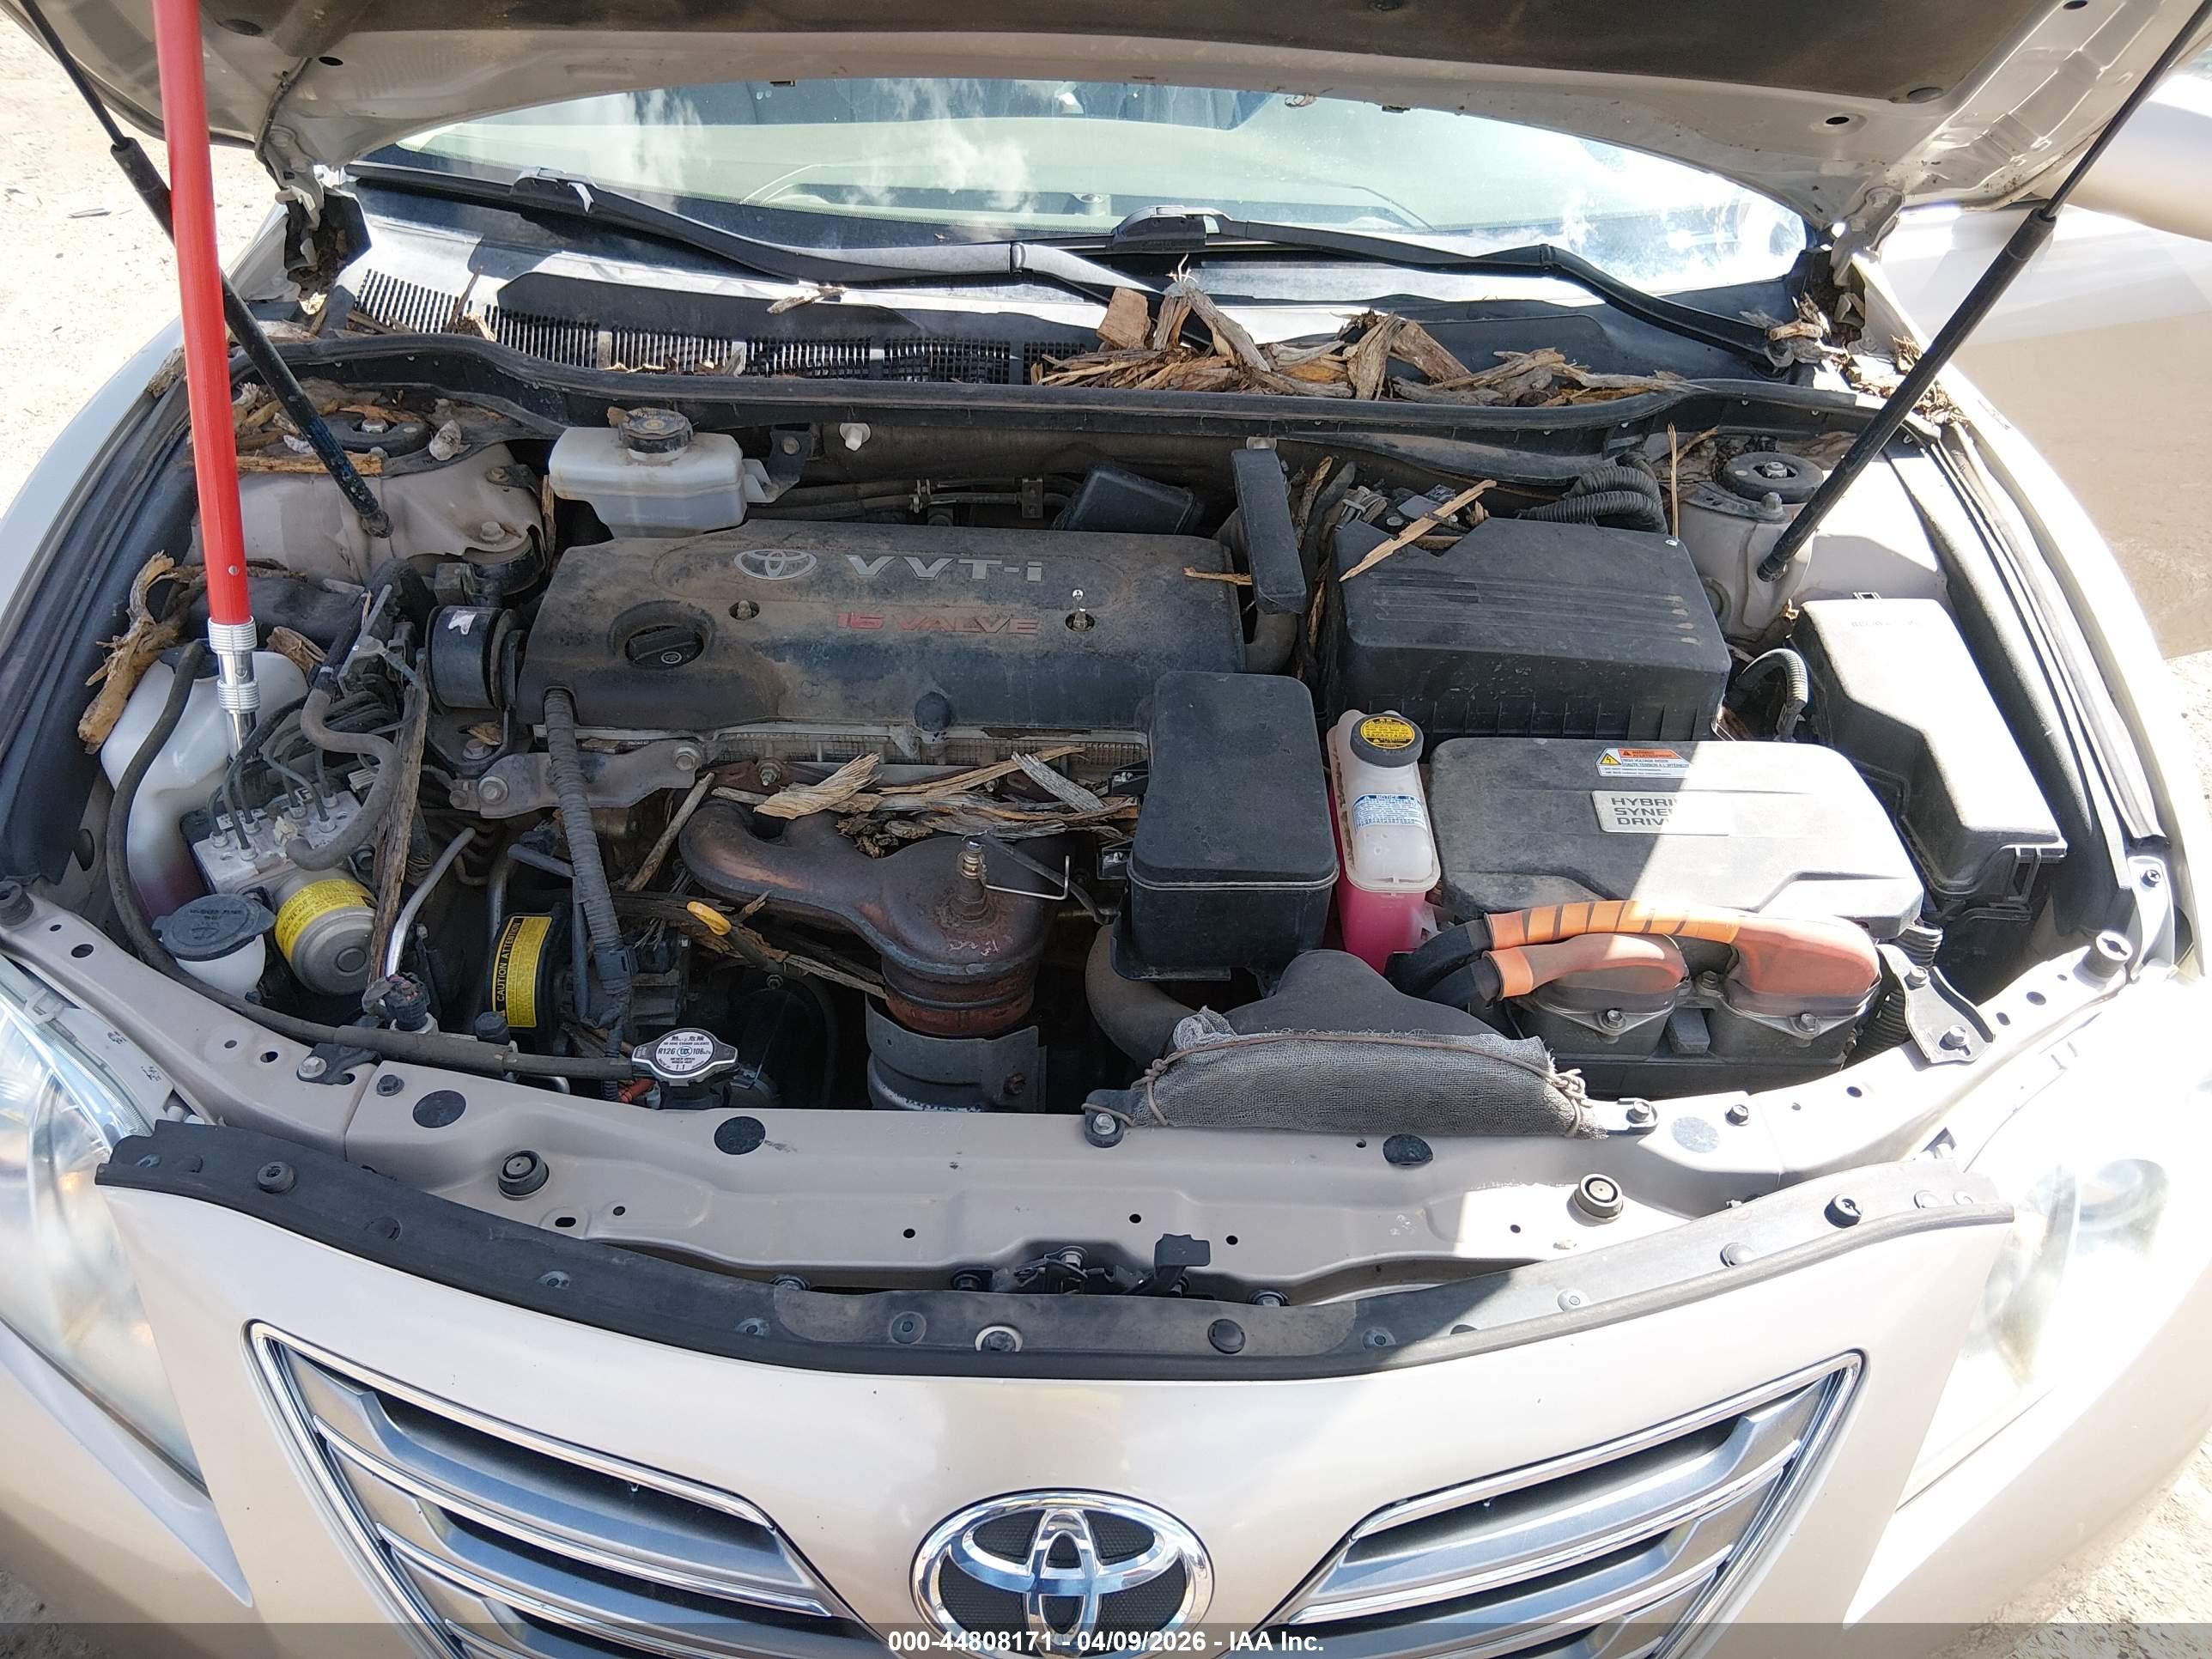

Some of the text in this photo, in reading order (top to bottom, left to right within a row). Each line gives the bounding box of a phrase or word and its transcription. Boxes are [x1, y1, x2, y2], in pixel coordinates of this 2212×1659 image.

[845, 555, 1042, 582] VVT-i
[838, 612, 1038, 635] 16 VALVE
[1611, 797, 1677, 806] HYBRI
[1613, 808, 1673, 817] SYNE
[1616, 817, 1669, 825] DRIV
[496, 922, 521, 1002] CAUTION ATTENTION
